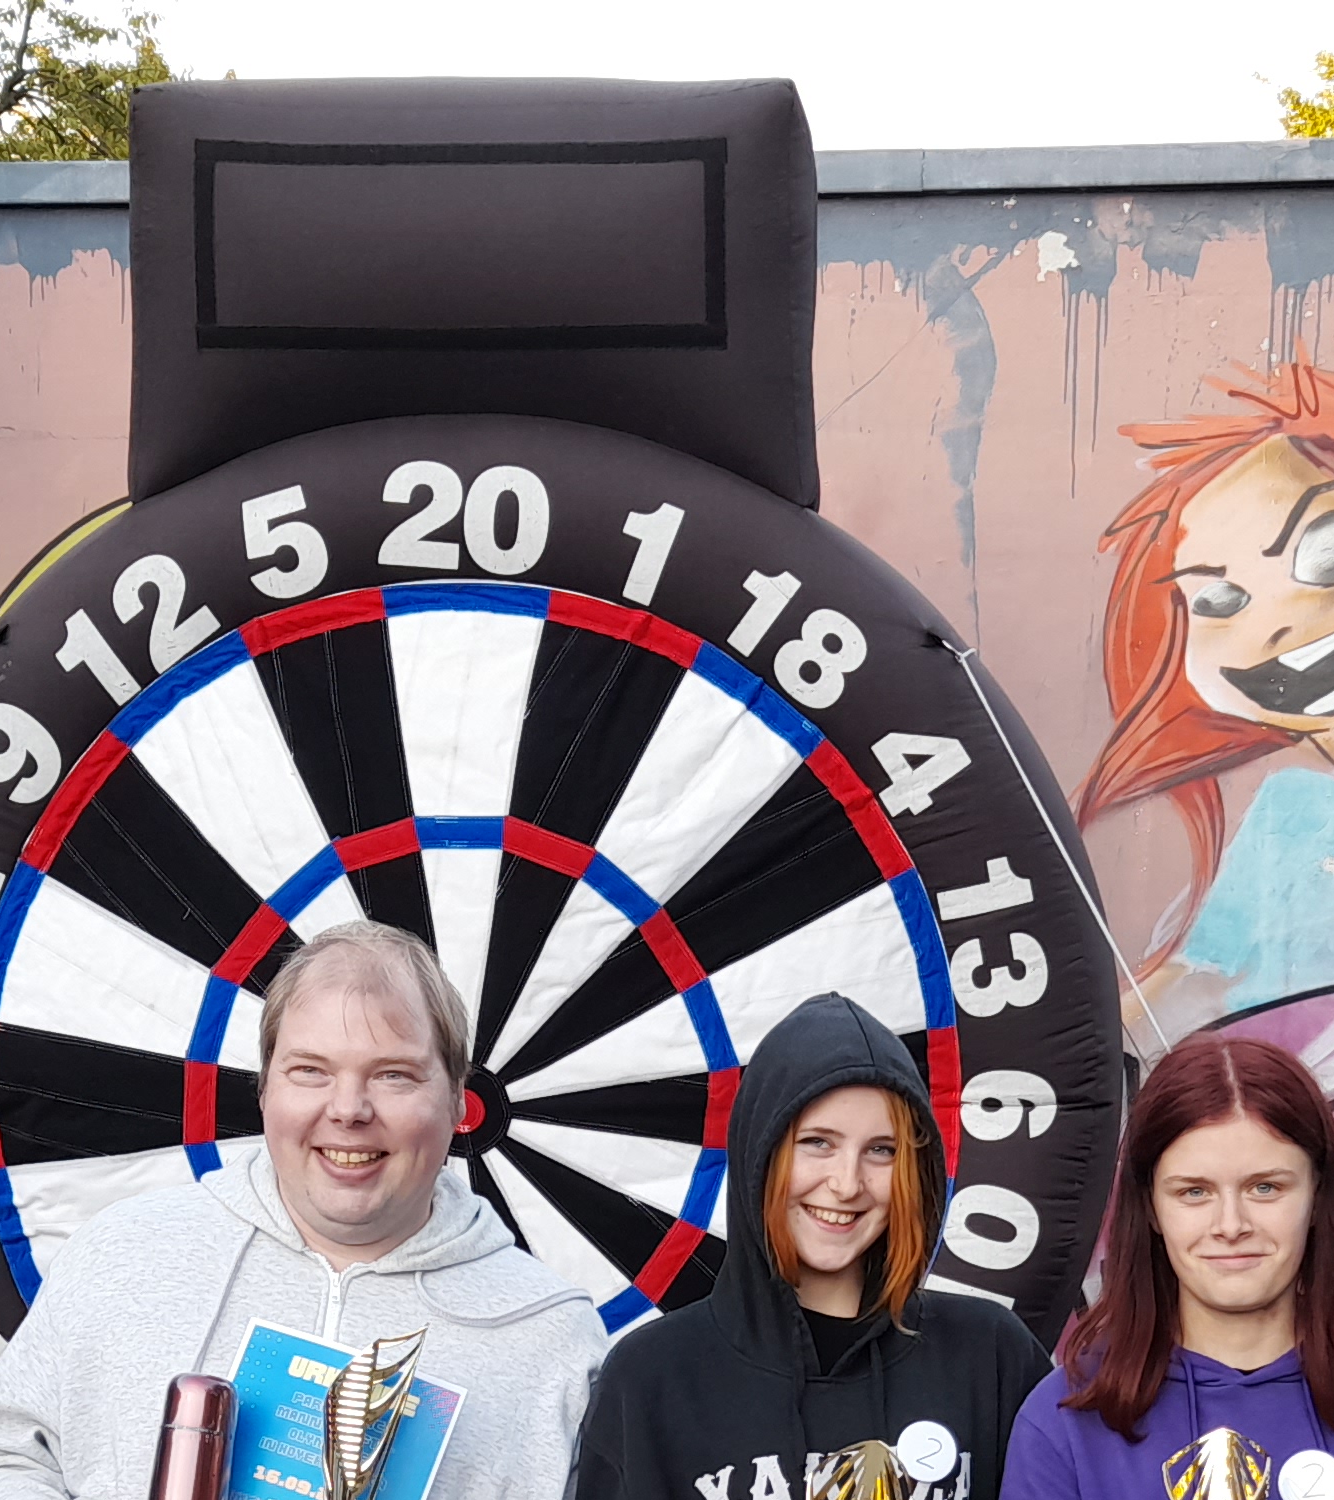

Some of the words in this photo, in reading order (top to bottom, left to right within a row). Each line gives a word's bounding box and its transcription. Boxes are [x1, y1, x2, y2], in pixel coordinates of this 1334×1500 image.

[242, 485, 328, 598] 5
[377, 461, 550, 576] 20
[623, 503, 685, 606] 1
[55, 554, 221, 706] 12
[727, 570, 867, 708] 18
[871, 733, 971, 817] 4
[937, 857, 1048, 1017] 13
[960, 1070, 1057, 1141] 6
[916, 1437, 943, 1470] 2
[1302, 1464, 1326, 1498] 2
